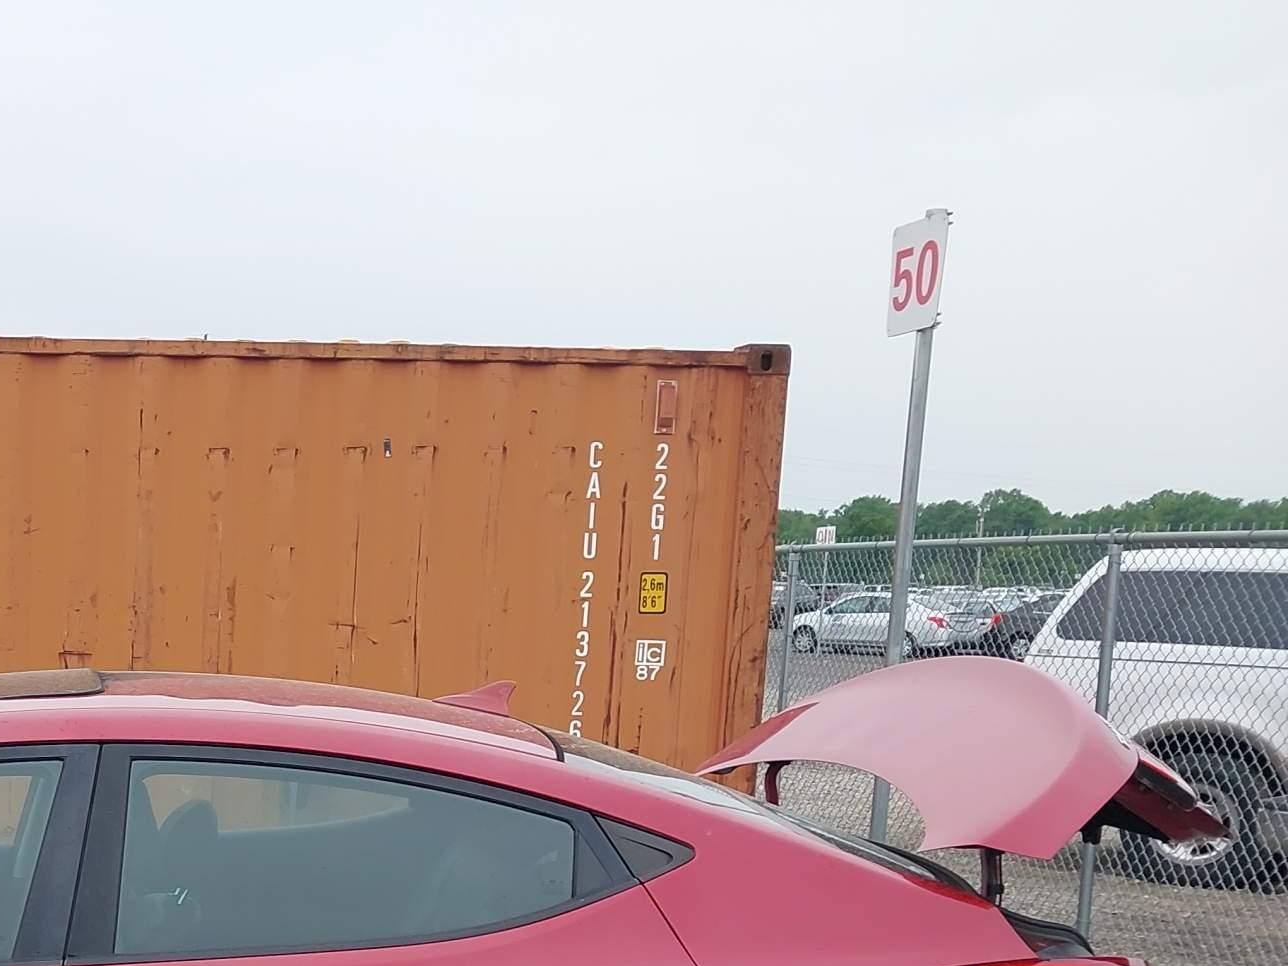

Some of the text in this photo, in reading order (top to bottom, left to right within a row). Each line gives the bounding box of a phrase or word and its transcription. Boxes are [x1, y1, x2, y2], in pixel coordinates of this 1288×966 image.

[893, 240, 939, 312] 50
[583, 441, 604, 559] CAIU
[650, 443, 670, 560] 22G1
[636, 665, 661, 681] 87
